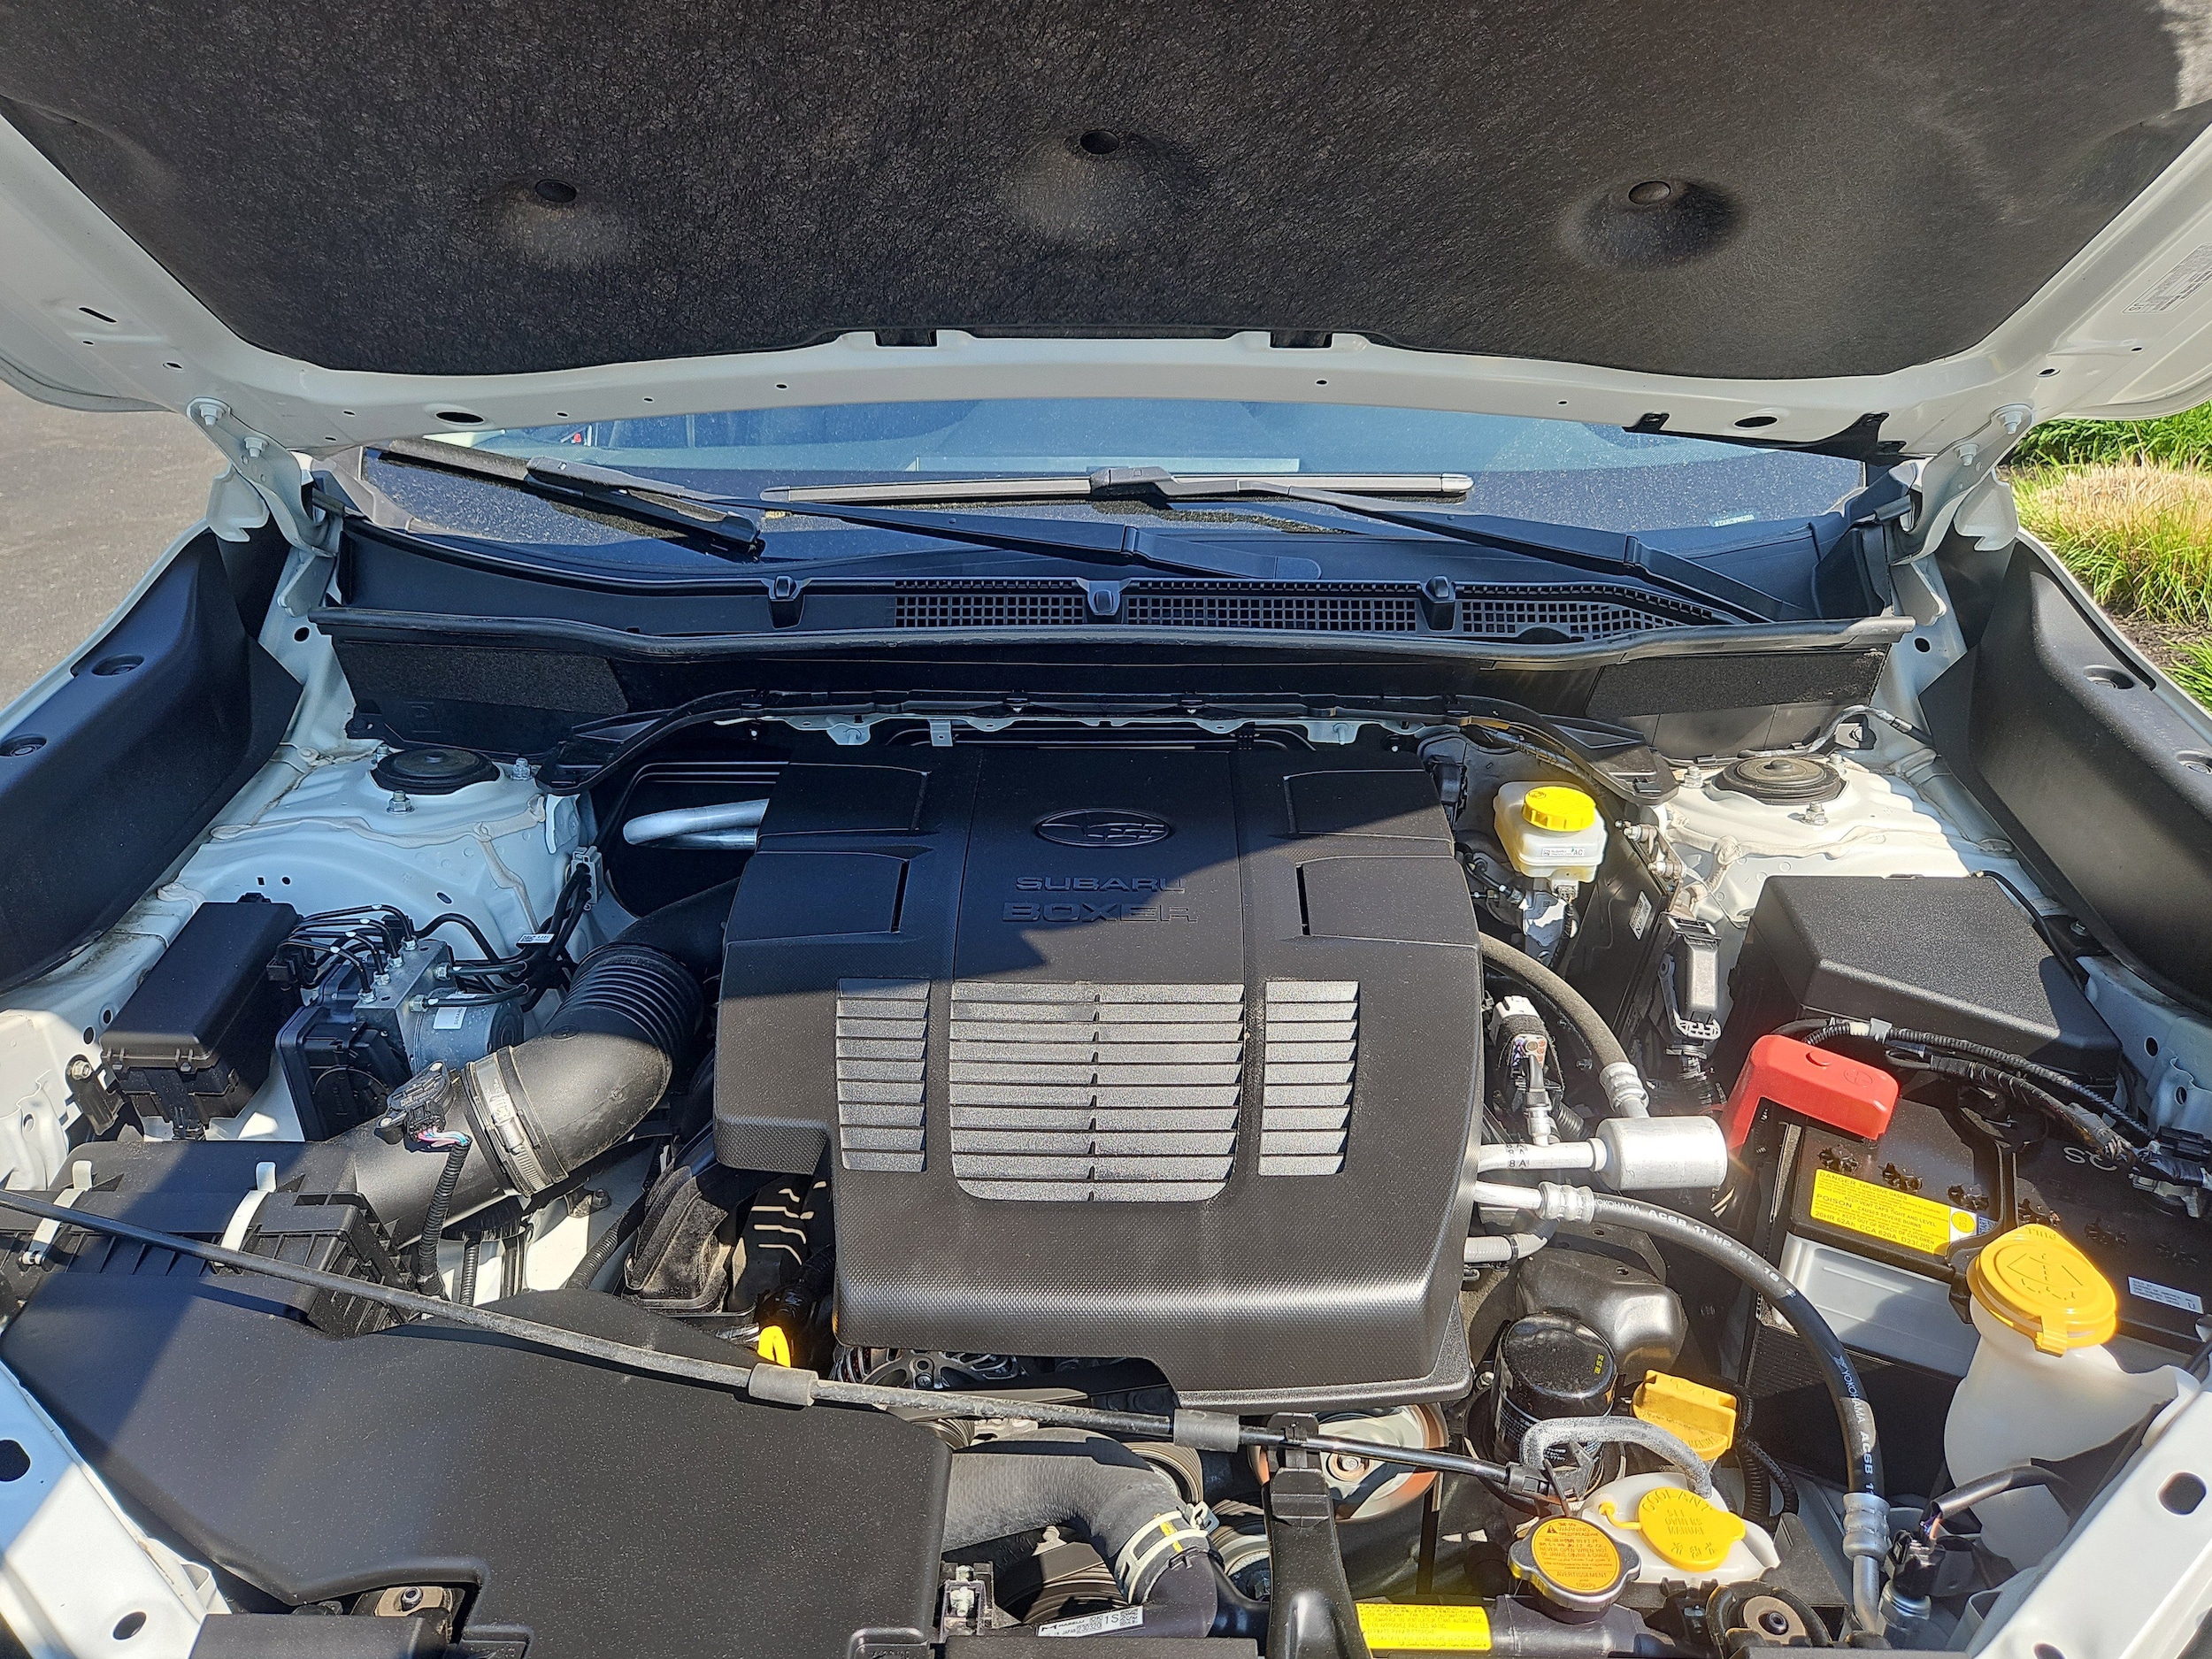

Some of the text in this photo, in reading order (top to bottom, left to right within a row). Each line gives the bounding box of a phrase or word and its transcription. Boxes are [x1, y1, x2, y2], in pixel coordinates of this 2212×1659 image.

[1016, 877, 1186, 893] SUBARU
[1002, 902, 1198, 923] BOXER
[1819, 1171, 1856, 1186] DANGER
[1859, 1184, 1888, 1194] EXPLOSIVE
[1816, 1194, 1921, 1228] POISON CAUSES SEVERE BURNS
[1593, 1198, 1641, 1215] YOKOHAMA
[1648, 1210, 1687, 1227] AC6B
[1694, 1225, 1708, 1237] 11
[1712, 1234, 1732, 1248] HP
[1738, 1249, 1755, 1266] BL
[1815, 1211, 1834, 1221] 20HR
[1836, 1217, 1855, 1227] 62Ah
[1859, 1225, 1877, 1233] CCA
[1878, 1230, 1897, 1240] 620A
[1878, 1225, 1897, 1233] REACH
[1906, 1233, 1934, 1245] CHILDREN
[1841, 1369, 1866, 1425] YOKOHAMA
[1860, 1431, 1873, 1475] AC6B
[1641, 1489, 1713, 1512] COOLANT
